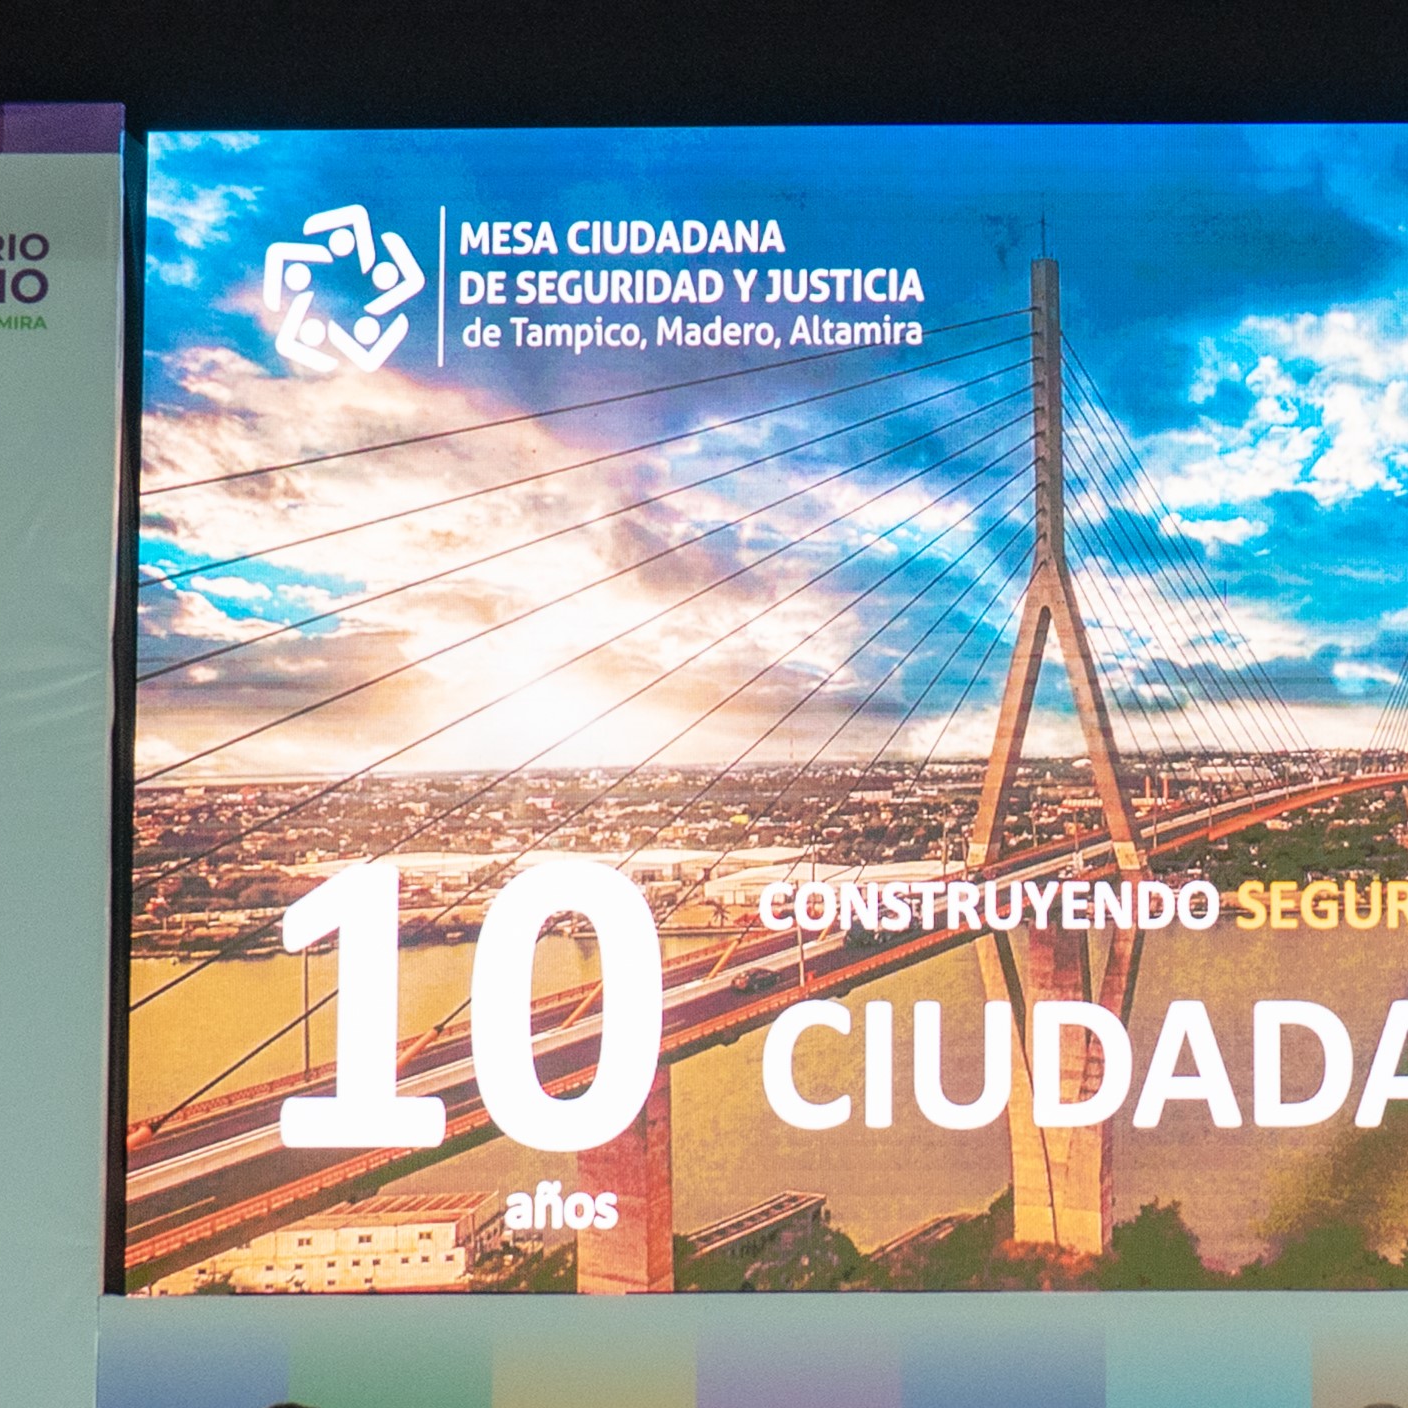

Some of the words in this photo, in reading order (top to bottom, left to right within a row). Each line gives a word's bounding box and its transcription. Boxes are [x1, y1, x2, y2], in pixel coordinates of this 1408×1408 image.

[460, 222, 559, 255] MESA
[568, 220, 785, 254] CIUDADANA
[460, 271, 506, 305] DE
[516, 269, 724, 304] SEGURIDAD
[734, 269, 757, 302] Y
[765, 268, 924, 303] JUSTICIA
[463, 317, 501, 348] de
[510, 316, 647, 355] Tampico,
[657, 316, 781, 349] Madero,
[790, 315, 922, 345] Altamira
[757, 880, 1220, 931] CONSTRUYENDO
[280, 859, 663, 1152] 10
[504, 1180, 619, 1230] años
